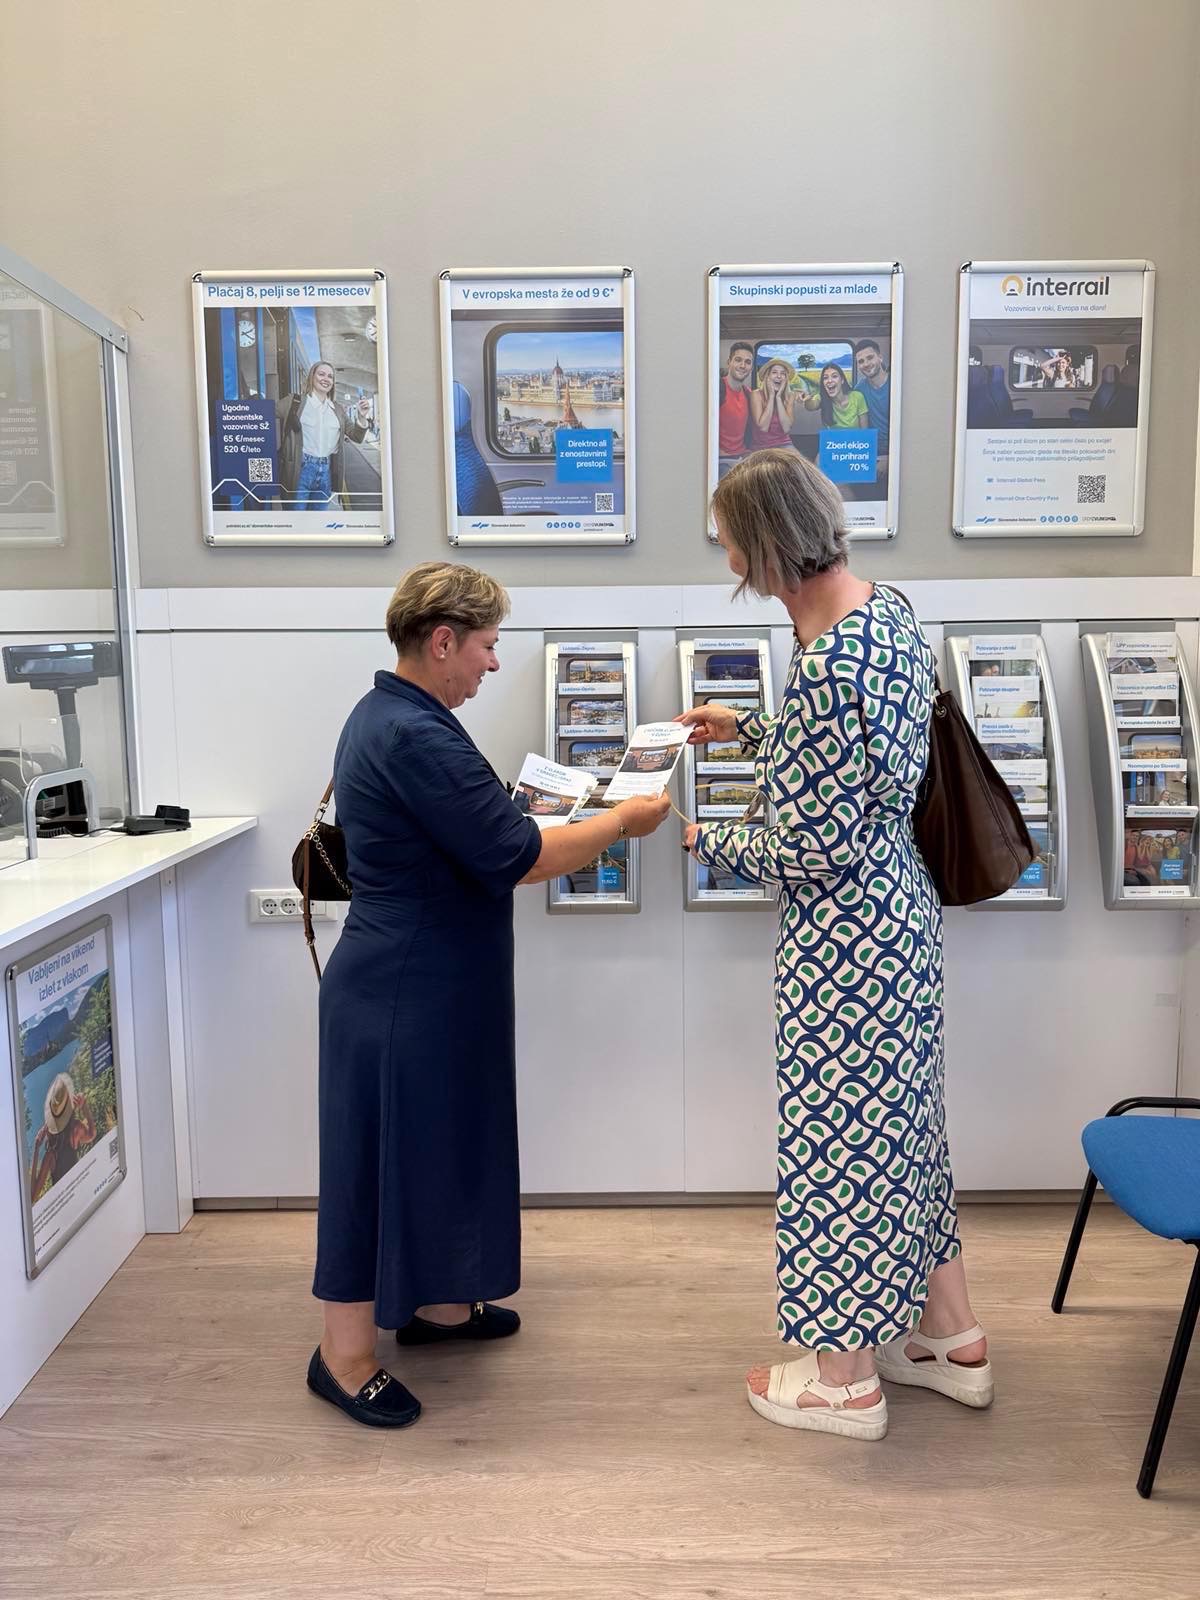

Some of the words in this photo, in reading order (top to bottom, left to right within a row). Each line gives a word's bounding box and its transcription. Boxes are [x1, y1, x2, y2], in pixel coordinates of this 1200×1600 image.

[208, 286, 244, 298] Plačaj
[246, 286, 258, 298] 8,
[260, 286, 284, 298] pelji
[286, 288, 300, 296] se
[303, 286, 315, 296] 12
[318, 287, 371, 296] mesecev
[730, 284, 784, 296] Skupinski
[786, 285, 827, 296] popusti
[844, 284, 878, 294] mlade
[1026, 276, 1110, 296] interrail
[462, 289, 470, 299] V
[472, 288, 522, 300] evropska
[525, 289, 558, 298] mesta
[561, 288, 574, 298] že
[576, 288, 590, 298] od
[593, 288, 600, 297] 9
[222, 404, 250, 413] Ugodne
[259, 421, 269, 430] SŽ
[224, 435, 234, 443] 65
[848, 442, 869, 450] ekipo
[840, 453, 869, 461] prihrani
[28, 955, 60, 985] Vabljeni
[61, 954, 71, 966] na
[72, 936, 95, 962] vikend
[39, 980, 56, 1001] izlet
[57, 980, 62, 990] z
[62, 964, 88, 986] vlakom
